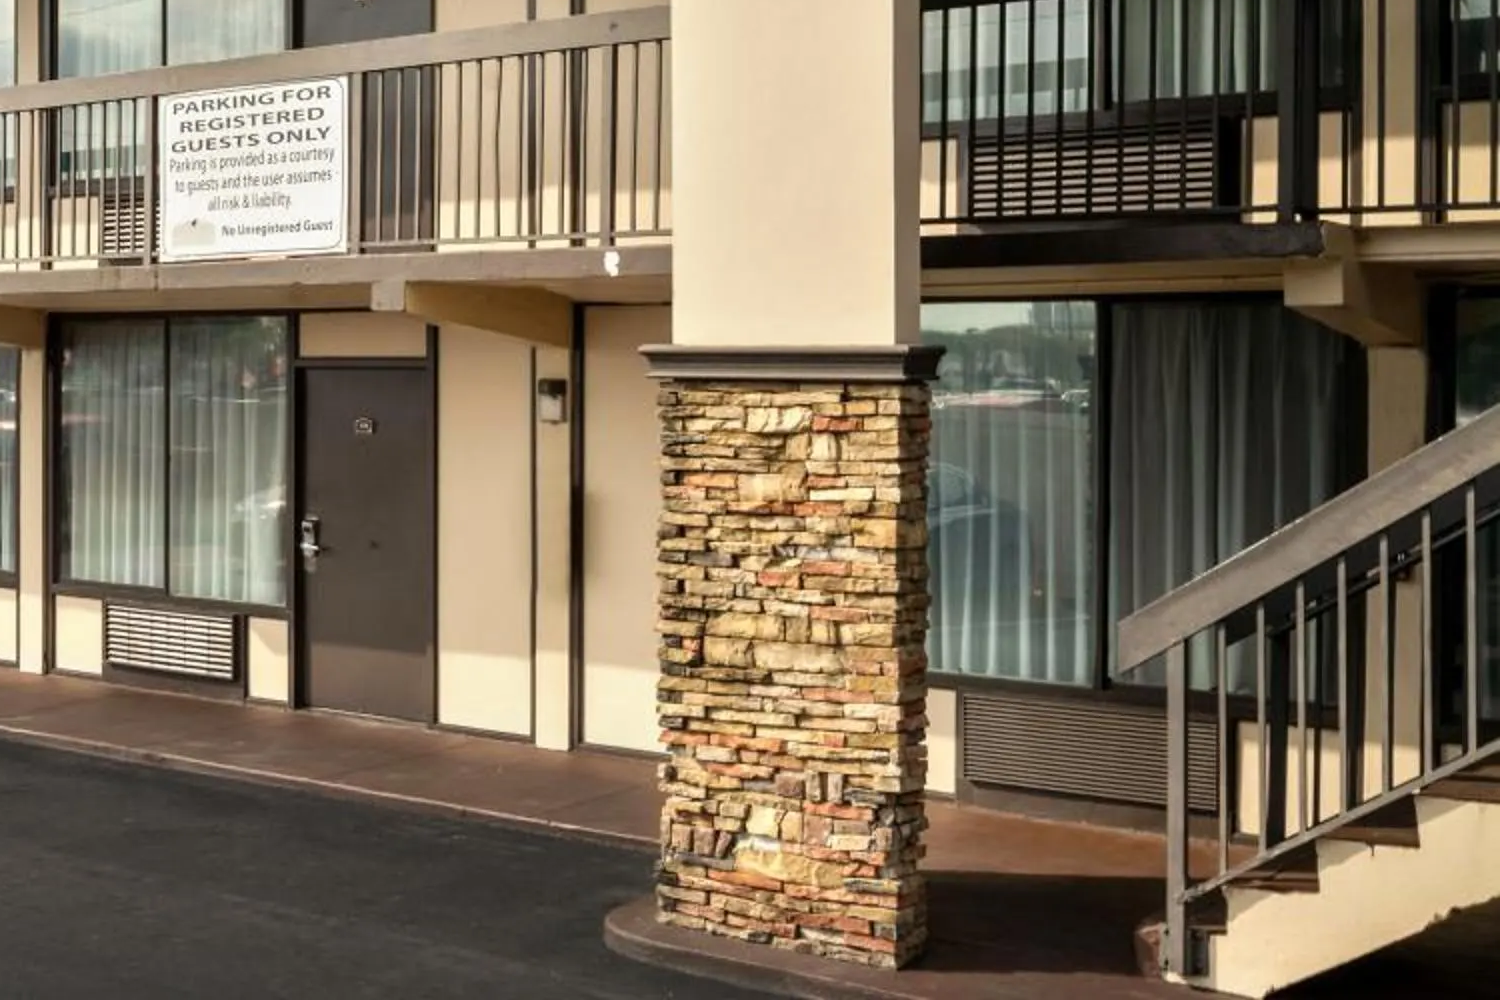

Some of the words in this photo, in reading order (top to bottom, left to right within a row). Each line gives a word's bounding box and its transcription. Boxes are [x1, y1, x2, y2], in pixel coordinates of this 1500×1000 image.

[172, 92, 275, 115] PARKING
[281, 85, 331, 103] FOR
[179, 107, 325, 133] REGISTERED
[171, 133, 260, 153] GUESTS
[267, 126, 331, 145] ONLY
[169, 156, 207, 174] Parking
[209, 157, 217, 169] is
[219, 151, 264, 171] provided
[267, 152, 279, 165] as
[289, 147, 335, 163] courtesy
[175, 179, 186, 193] to
[187, 177, 219, 195] guests
[221, 176, 241, 188] and
[243, 174, 260, 187] the
[262, 173, 284, 186] user
[287, 169, 332, 184] assumes
[207, 196, 221, 211] all
[221, 195, 240, 210] risk
[241, 195, 249, 209] &
[221, 225, 236, 236] No
[237, 220, 301, 236] Unregistered
